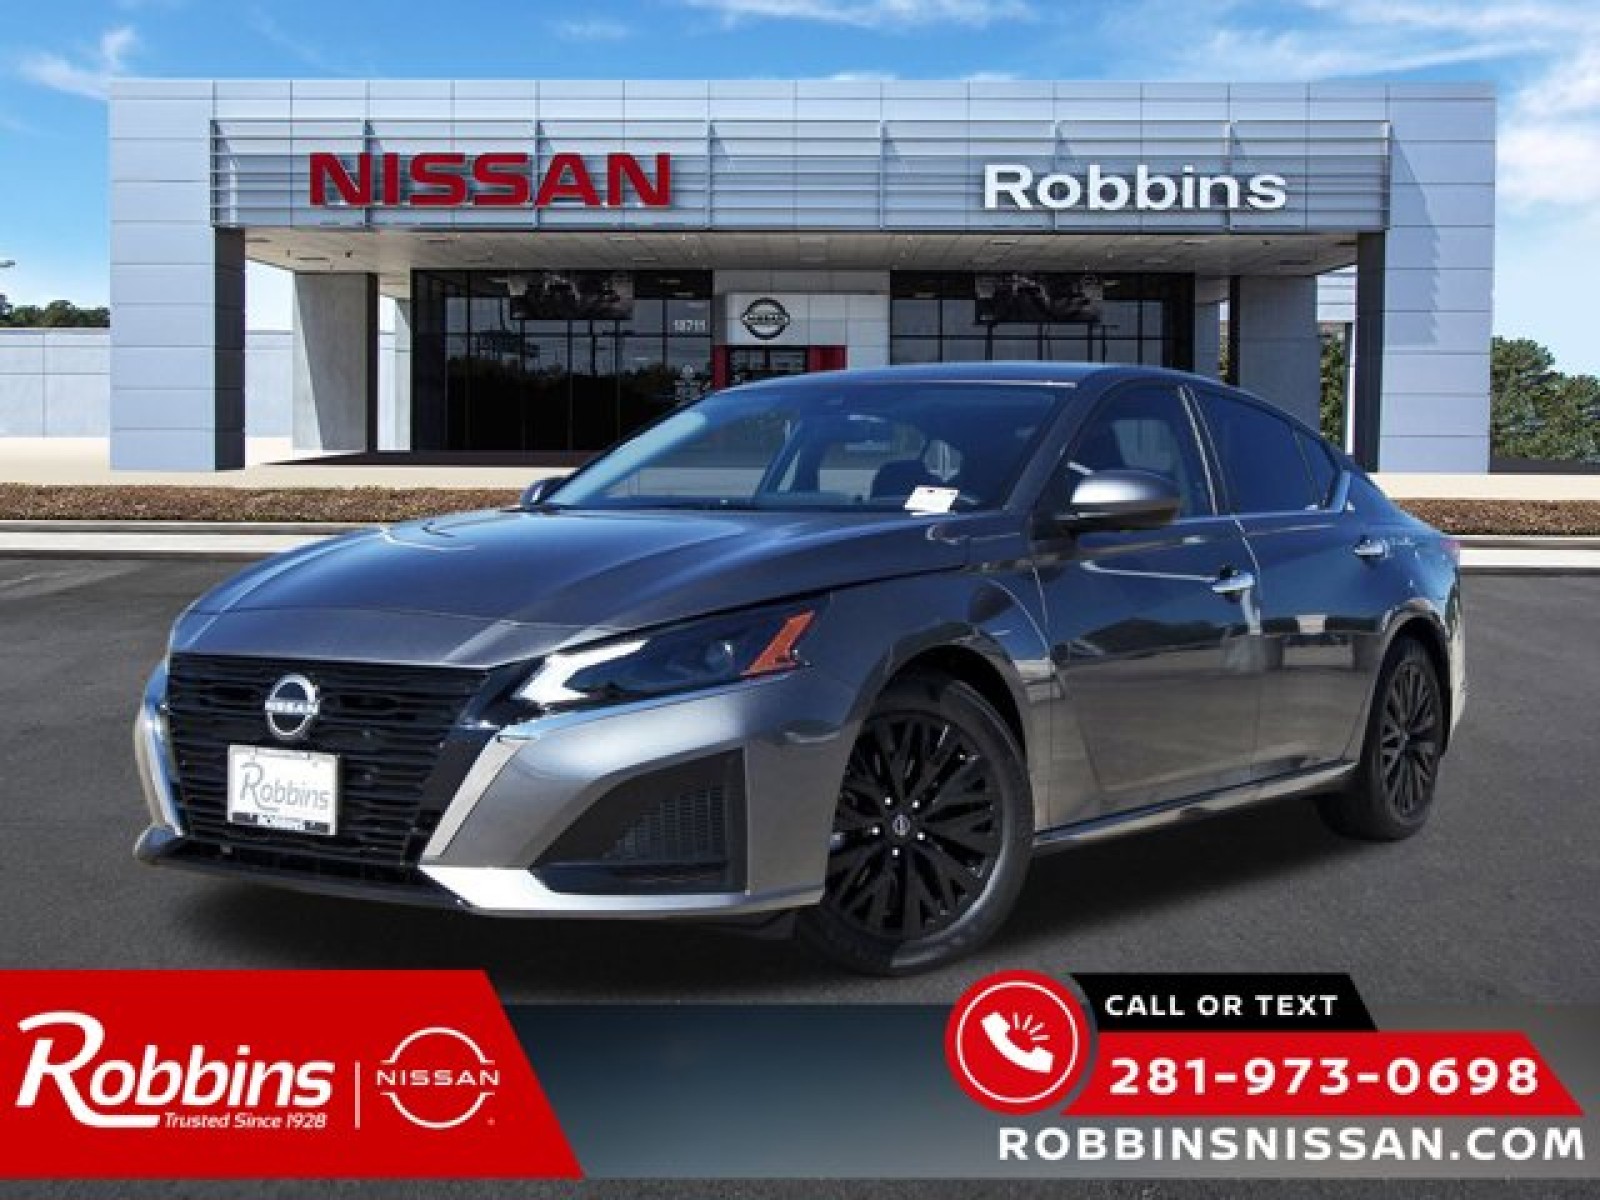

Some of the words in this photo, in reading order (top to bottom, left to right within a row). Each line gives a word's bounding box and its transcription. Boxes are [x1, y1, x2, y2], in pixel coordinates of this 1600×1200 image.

[309, 152, 672, 206] NISSAN
[984, 164, 1286, 211] Robbins
[239, 761, 330, 812] Robbins
